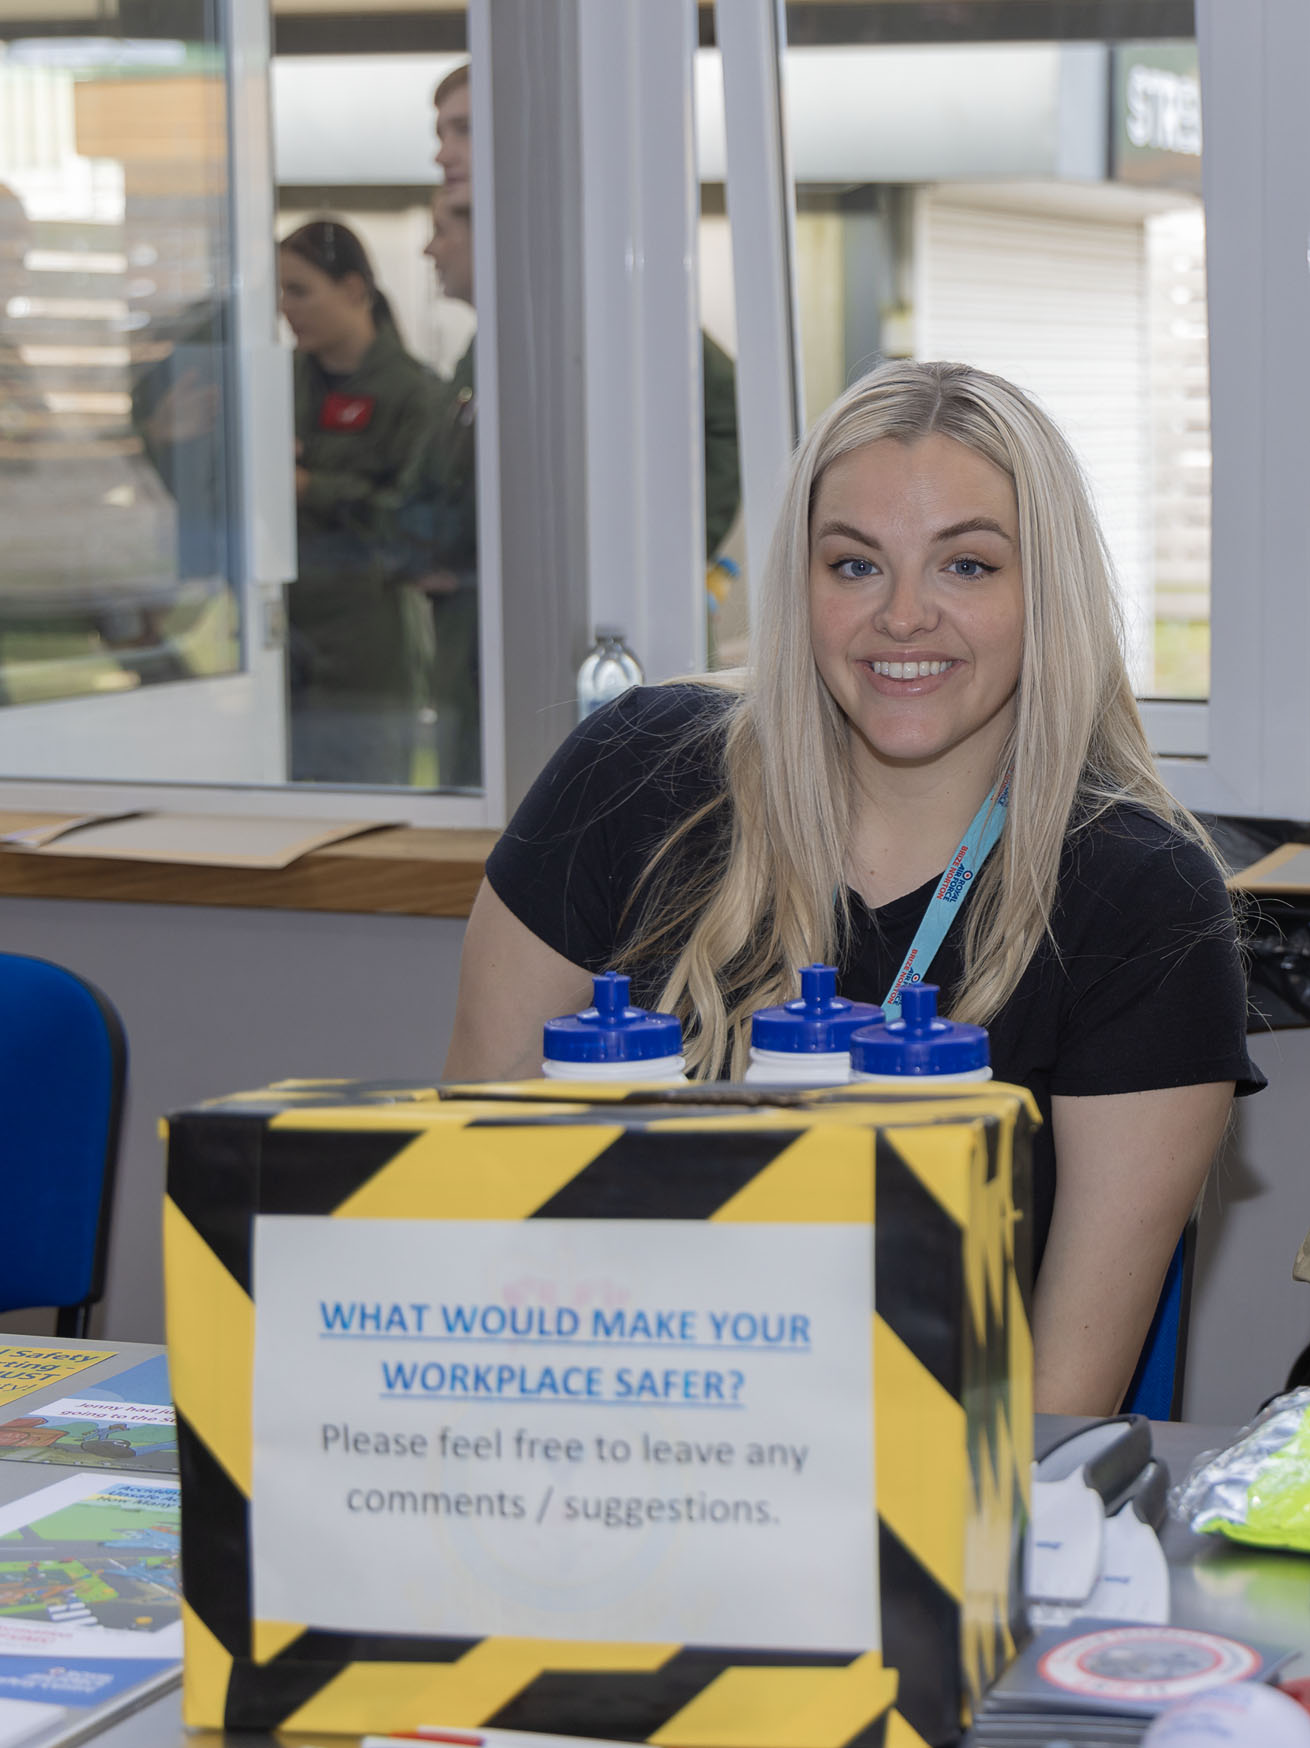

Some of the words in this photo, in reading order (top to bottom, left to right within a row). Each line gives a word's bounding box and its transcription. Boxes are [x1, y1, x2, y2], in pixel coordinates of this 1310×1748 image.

[952, 845, 968, 867] BRIZE
[955, 863, 965, 877] AIR
[936, 866, 957, 900] NORTON
[943, 876, 959, 902] FORCE
[950, 879, 966, 902] ROYAL
[904, 948, 918, 971] BRIZE
[319, 1301, 430, 1333] WHAT
[441, 1304, 580, 1337] WOULD
[592, 1308, 698, 1341] MAKE
[709, 1311, 811, 1344] YOUR
[8, 1350, 99, 1363] Safety
[0, 1371, 61, 1381] UST
[381, 1361, 603, 1398] WORKPLACE
[614, 1367, 746, 1401] SAFER?
[59, 1410, 107, 1419] going
[131, 1412, 158, 1421] the
[78, 1402, 123, 1413] Jenny
[128, 1405, 155, 1413] had
[322, 1423, 428, 1456] Please
[439, 1426, 502, 1459] feel
[514, 1428, 585, 1463] free
[595, 1436, 632, 1464] to
[643, 1433, 735, 1465] leave
[746, 1442, 810, 1474] any
[347, 1487, 526, 1519] comments
[535, 1485, 555, 1524] /
[564, 1491, 780, 1528] suggestions.
